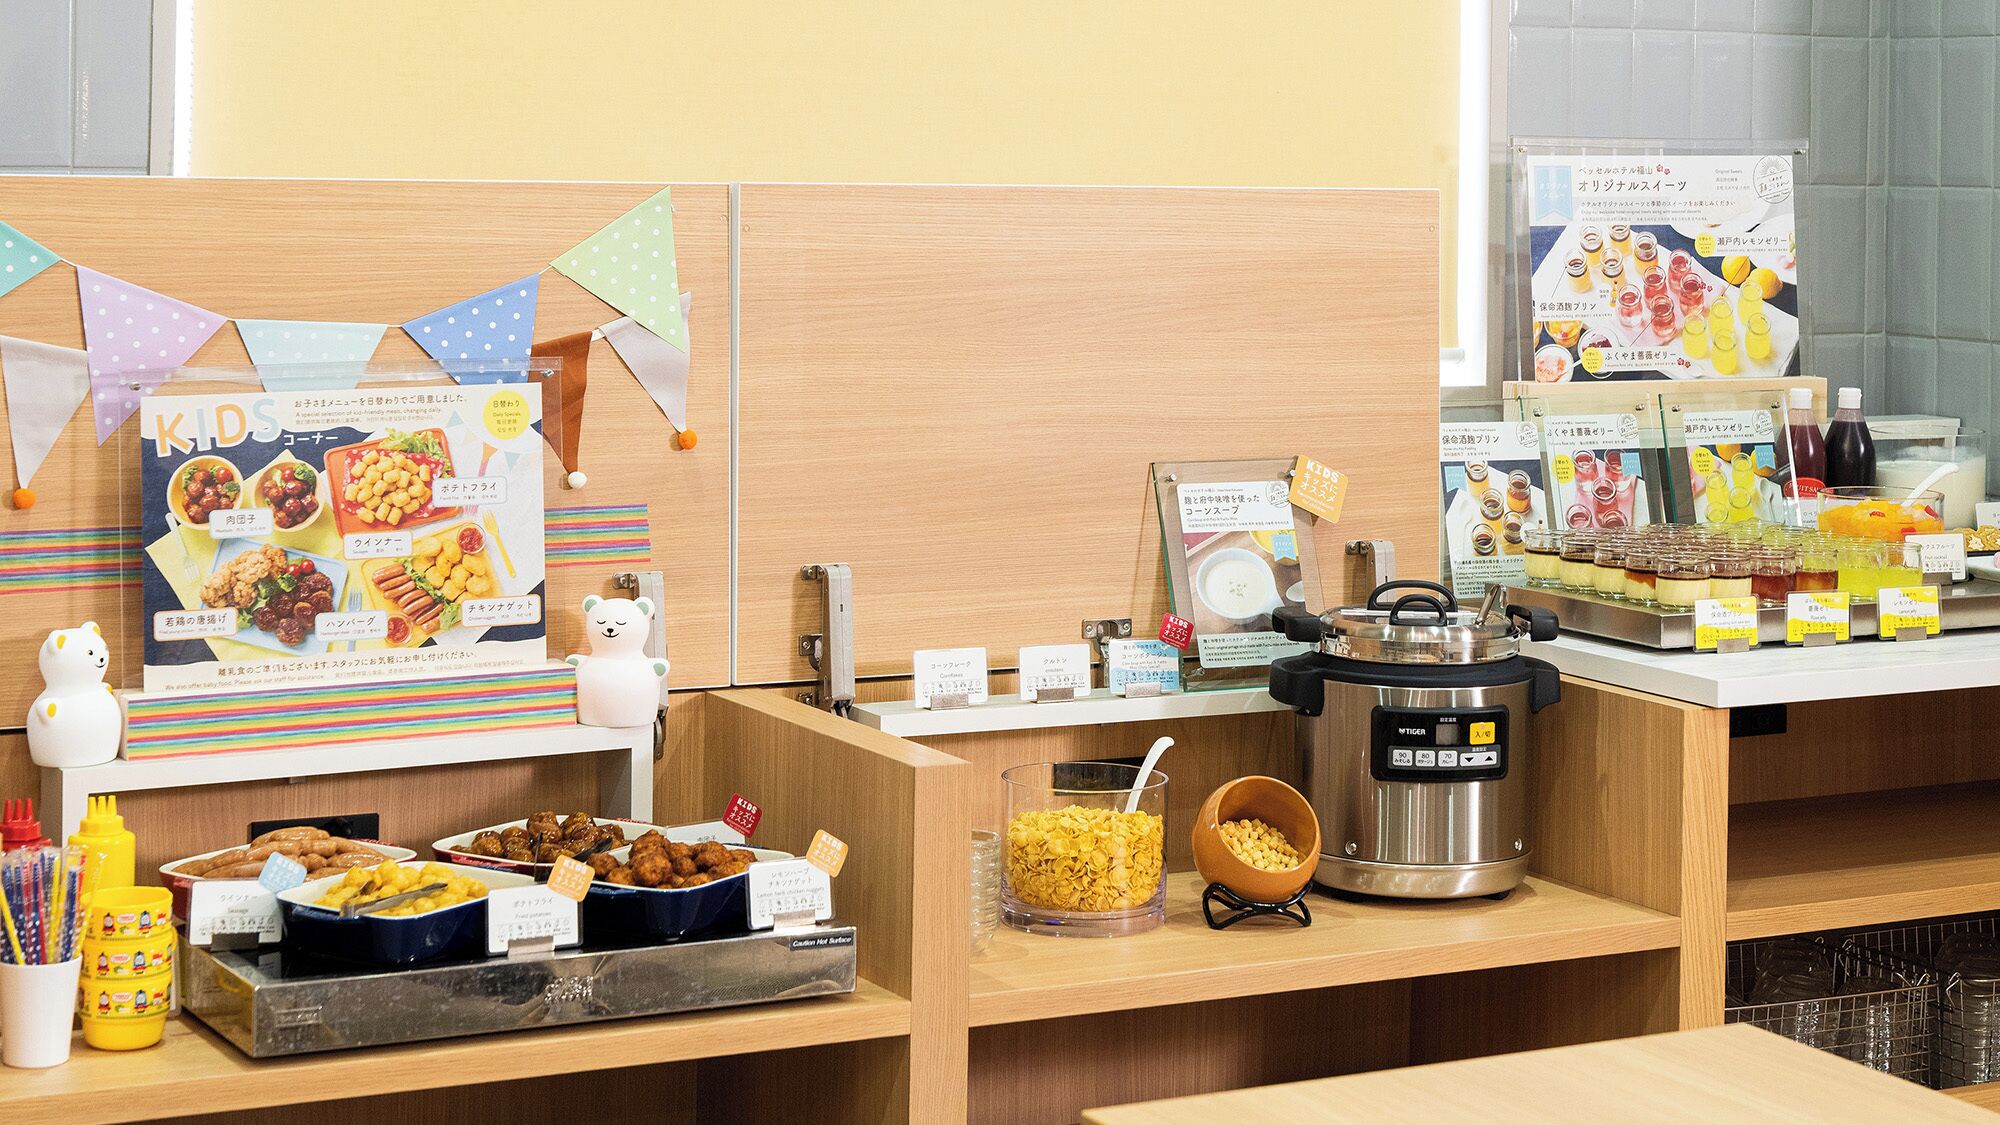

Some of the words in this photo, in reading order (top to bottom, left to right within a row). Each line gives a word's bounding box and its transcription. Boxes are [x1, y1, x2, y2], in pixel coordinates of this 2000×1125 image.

[1578, 165, 1653, 176] ベッセルホテル福山
[1578, 179, 1687, 193] オリジナルスイーツ
[1717, 236, 1787, 246] 瀬戸内レモンゼリー
[1539, 301, 1596, 312] 保命酒麹プリン
[1604, 351, 1676, 361] ふくやま薔薇ゼリー
[294, 394, 468, 408] お子さまメニューを日替わりでご用意しました。
[493, 400, 520, 408] 日替わり
[155, 397, 281, 458] KIDS
[1547, 427, 1614, 437] ふくやま薔薇ゼリー
[1684, 423, 1750, 434] 瀬戸内レモンゼリー
[283, 432, 339, 446] コーナー
[1442, 434, 1500, 444] 保命酒麹プリン
[1306, 460, 1340, 483] KIDS
[441, 482, 497, 494] ポテトフライ
[1304, 471, 1338, 495] キッズに
[1300, 481, 1336, 502] オススメ
[1184, 495, 1260, 505] 麹と府中味噌を使った
[1186, 504, 1240, 516] コーンスープ
[226, 514, 256, 525] 肉団子
[354, 538, 402, 548] ウインナー
[468, 600, 532, 614] チキンナゲット
[165, 612, 228, 628] 若鶏の唐揚げ
[326, 616, 376, 628] ハンバーグ
[1169, 616, 1188, 628] KIDS
[1166, 623, 1188, 636] キッズに
[1164, 630, 1186, 642] オススメ
[931, 660, 972, 670] コーンフレーク
[1406, 728, 1426, 736] TIGER
[1474, 730, 1491, 738] 入/切
[736, 797, 758, 814] KIDS
[729, 812, 753, 828] オススメ
[732, 805, 756, 823] キッズに
[821, 833, 843, 850] KIDS
[563, 859, 588, 874] KIDS
[772, 867, 810, 879] レモンハーブ
[769, 876, 812, 888] チキンナゲット
[514, 897, 553, 908] ポテトフライ
[792, 938, 816, 947] Caution
[816, 937, 829, 946] Hot
[830, 936, 852, 944] Surface
